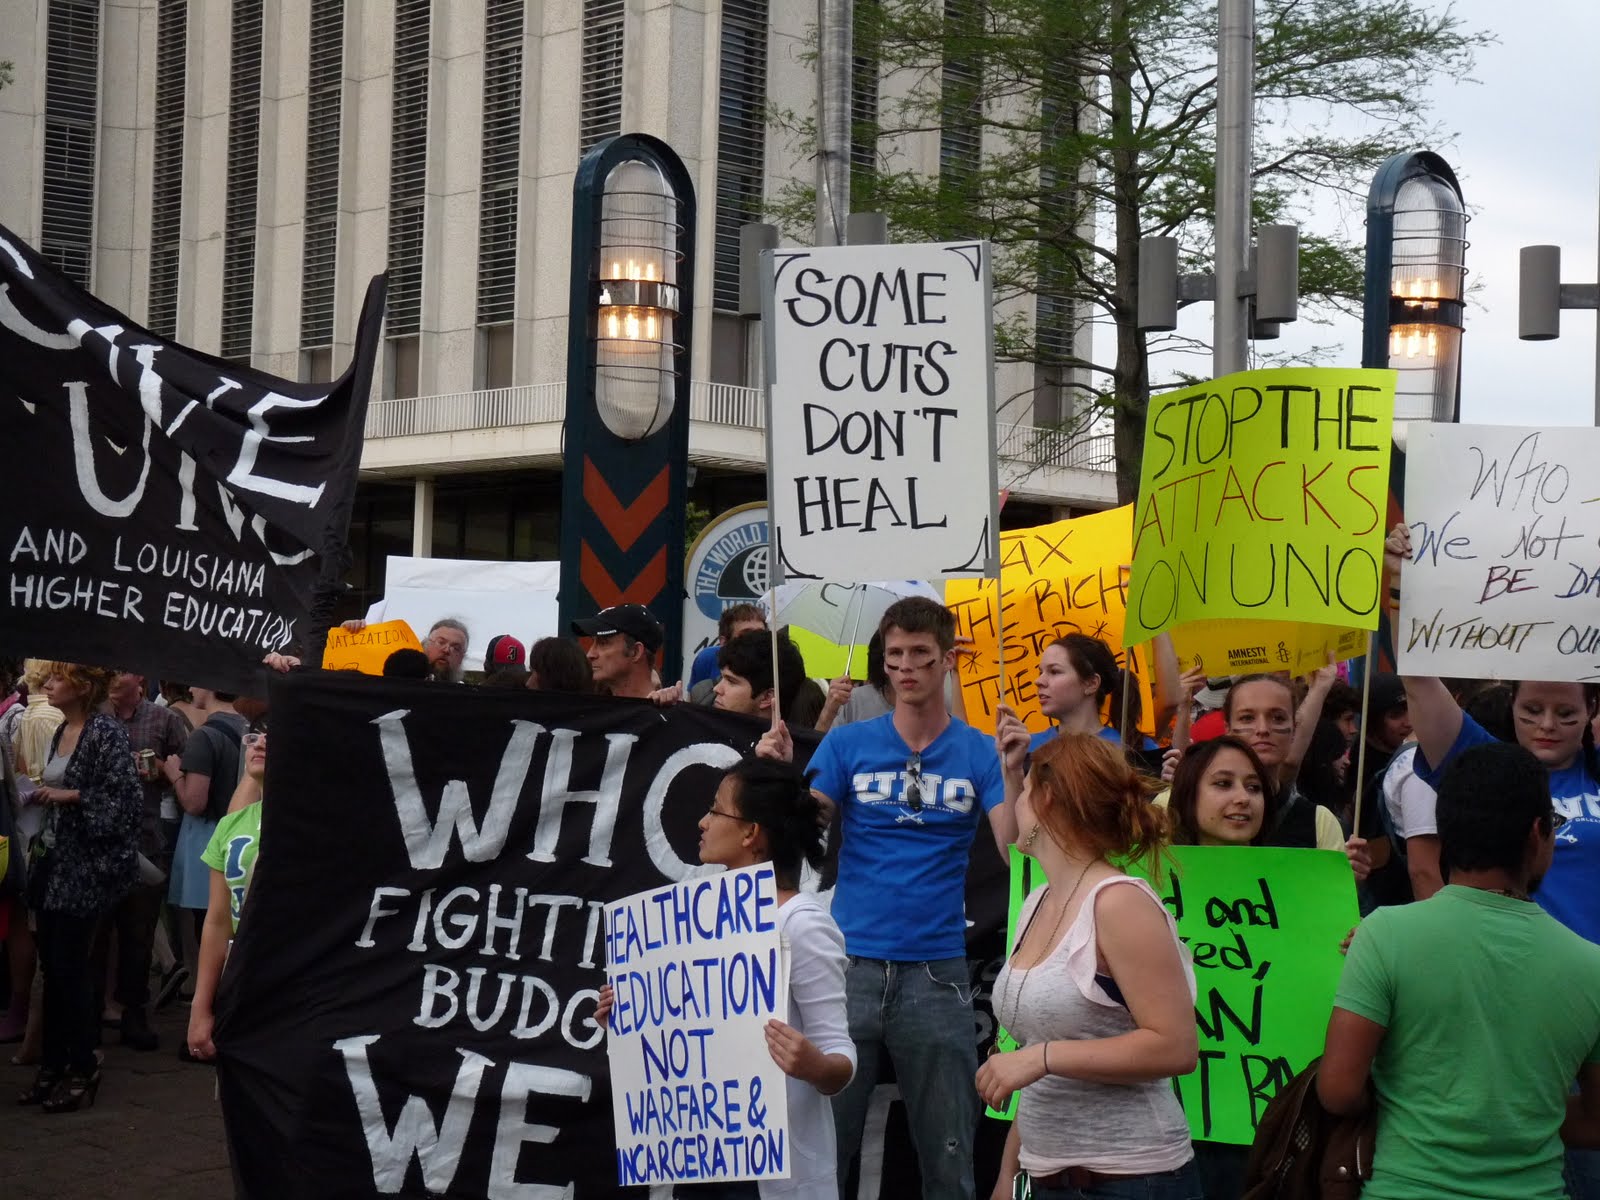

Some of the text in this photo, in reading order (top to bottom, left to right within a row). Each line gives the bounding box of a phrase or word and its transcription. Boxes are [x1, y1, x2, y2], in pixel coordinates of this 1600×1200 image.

[783, 267, 947, 327] SOME
[819, 338, 957, 396] CUTS
[803, 403, 957, 462] DON'T
[1152, 385, 1381, 481] STOP THE
[794, 476, 947, 536] HEAL
[1132, 461, 1379, 561] ATTACKS
[9, 526, 265, 598] AND LOUISIANA
[706, 522, 762, 564] WORLD
[696, 563, 721, 597] THE
[1025, 565, 1129, 622] RICH
[1138, 542, 1379, 630] ON UNO
[1475, 565, 1539, 604] BE
[10, 573, 297, 651] HIGHER EDUCATION
[1407, 608, 1555, 653] WITHOUT
[1227, 646, 1267, 660] AMNESTY
[1229, 656, 1270, 667] INTERNATIONAL
[852, 771, 976, 813] UNO
[355, 883, 604, 969] FIGHTI
[603, 870, 775, 965] HEALTHCARE
[1205, 878, 1279, 929] and
[414, 964, 605, 1050] BUDG
[641, 1028, 714, 1084] NOT
[332, 1034, 592, 1200] WE
[626, 1076, 767, 1136] WARFARE &
[617, 1128, 784, 1185] INCARCERATION
